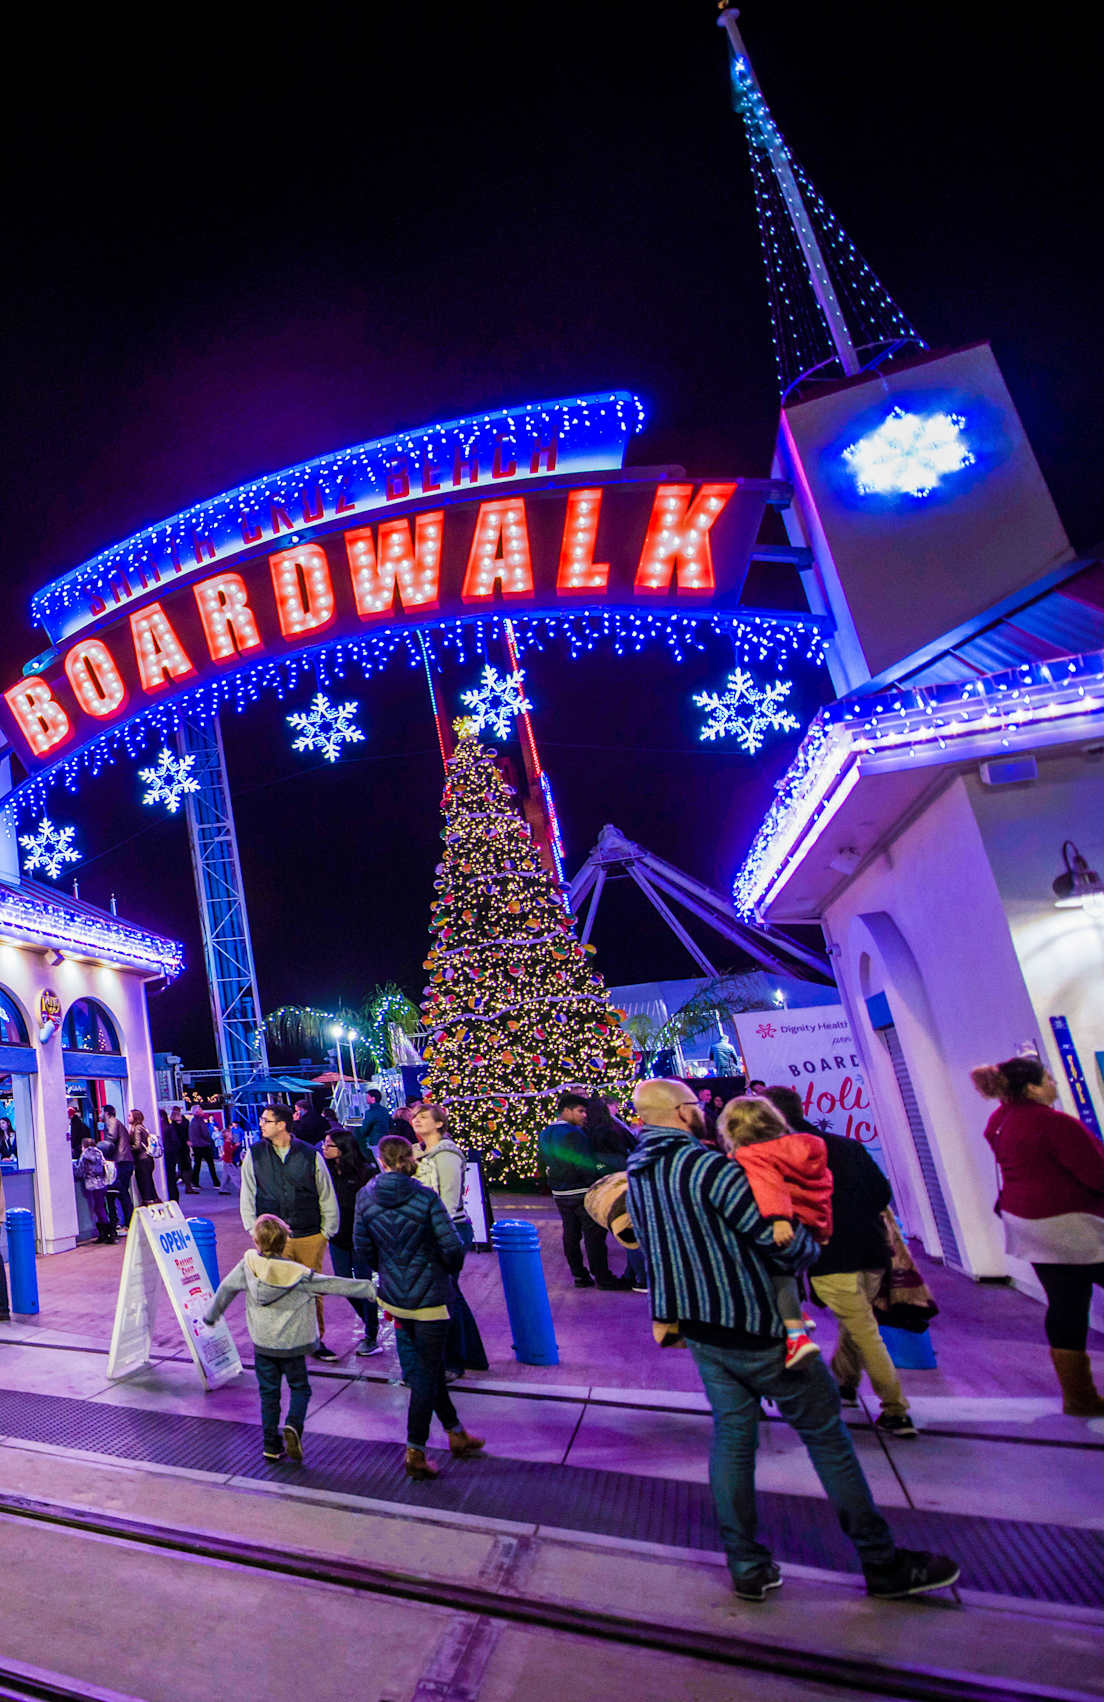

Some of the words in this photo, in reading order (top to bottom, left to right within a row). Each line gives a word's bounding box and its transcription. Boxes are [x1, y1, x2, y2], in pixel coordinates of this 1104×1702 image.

[385, 425, 558, 502] BEACH
[3, 481, 738, 760] BOARDWALK
[780, 1023, 816, 1035] Dignity
[159, 1228, 188, 1255] OPEN
